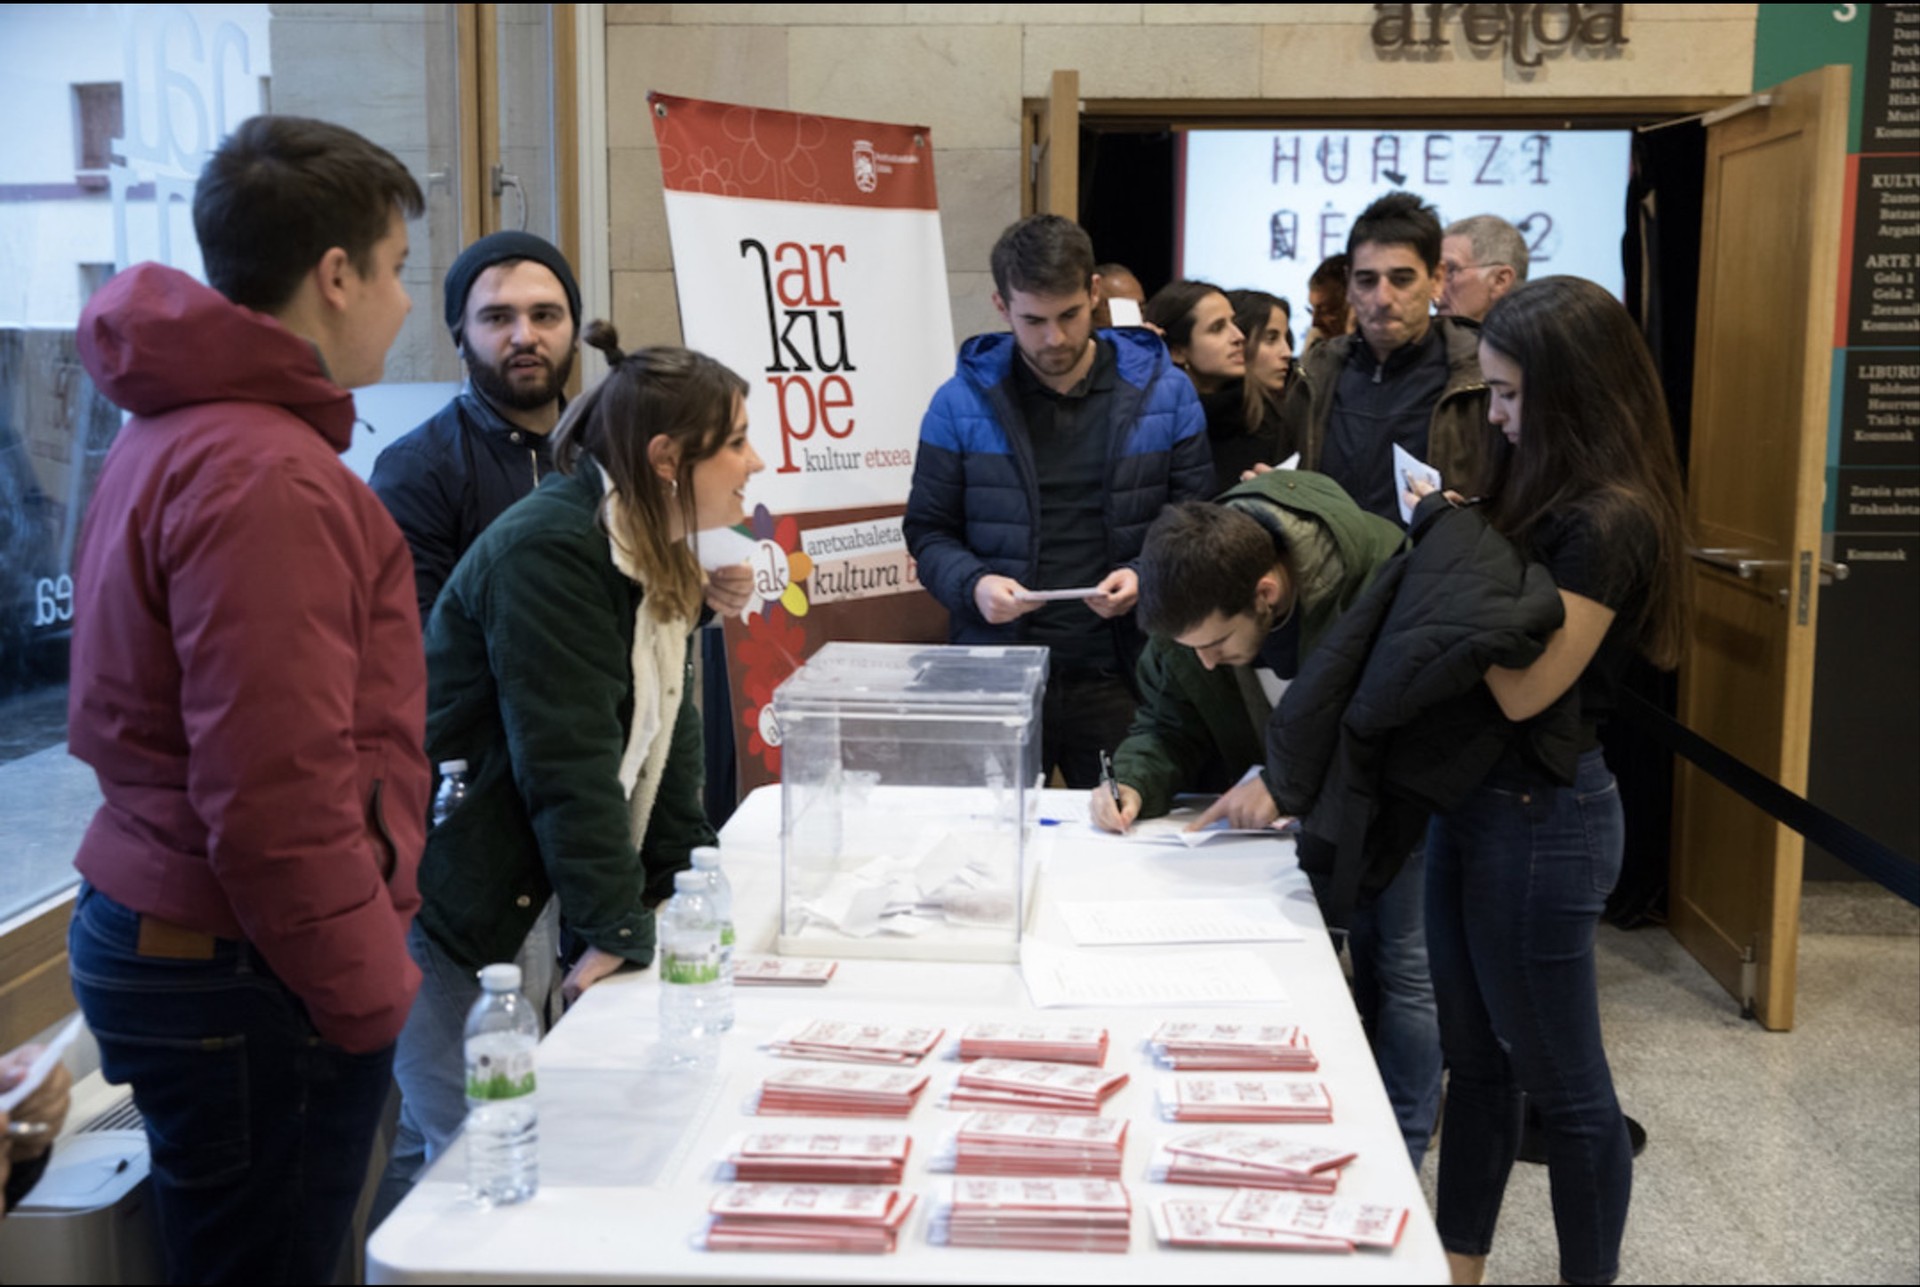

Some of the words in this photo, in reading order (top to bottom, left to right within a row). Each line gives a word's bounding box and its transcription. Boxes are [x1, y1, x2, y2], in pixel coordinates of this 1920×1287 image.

[774, 241, 847, 308] ar
[1865, 254, 1912, 269] ARTE
[767, 374, 856, 474] pe
[803, 446, 861, 473] kultur
[865, 447, 913, 468] etxea
[807, 524, 903, 557] aretxabaleta
[756, 543, 788, 594] ak
[813, 560, 900, 596] kultura
